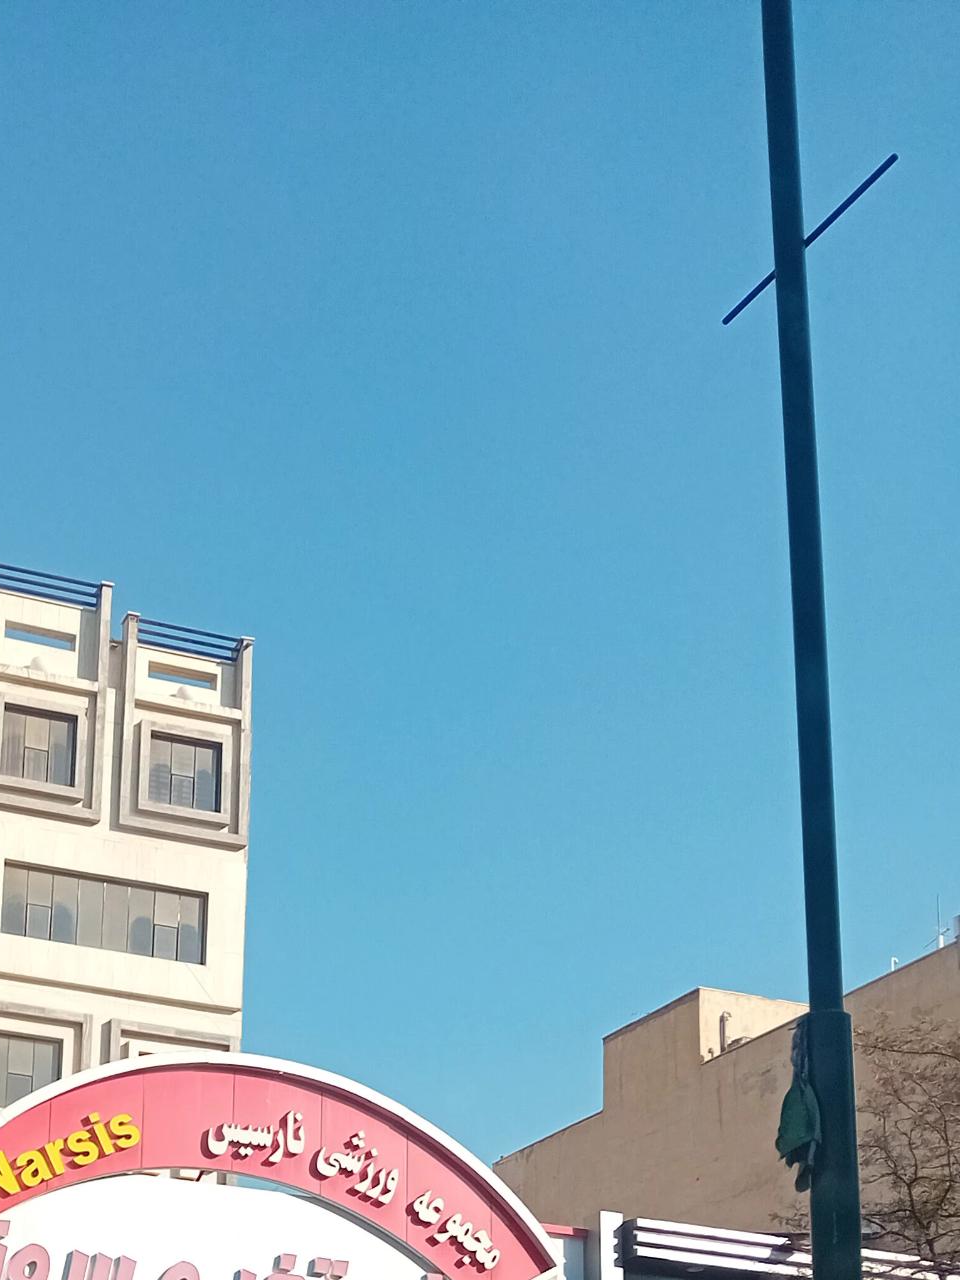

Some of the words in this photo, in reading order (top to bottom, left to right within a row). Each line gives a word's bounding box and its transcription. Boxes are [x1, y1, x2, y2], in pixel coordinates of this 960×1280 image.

[205, 1109, 305, 1164] نارسیس
[315, 1129, 400, 1205] ورزشی
[412, 1189, 502, 1271] مجموعه
